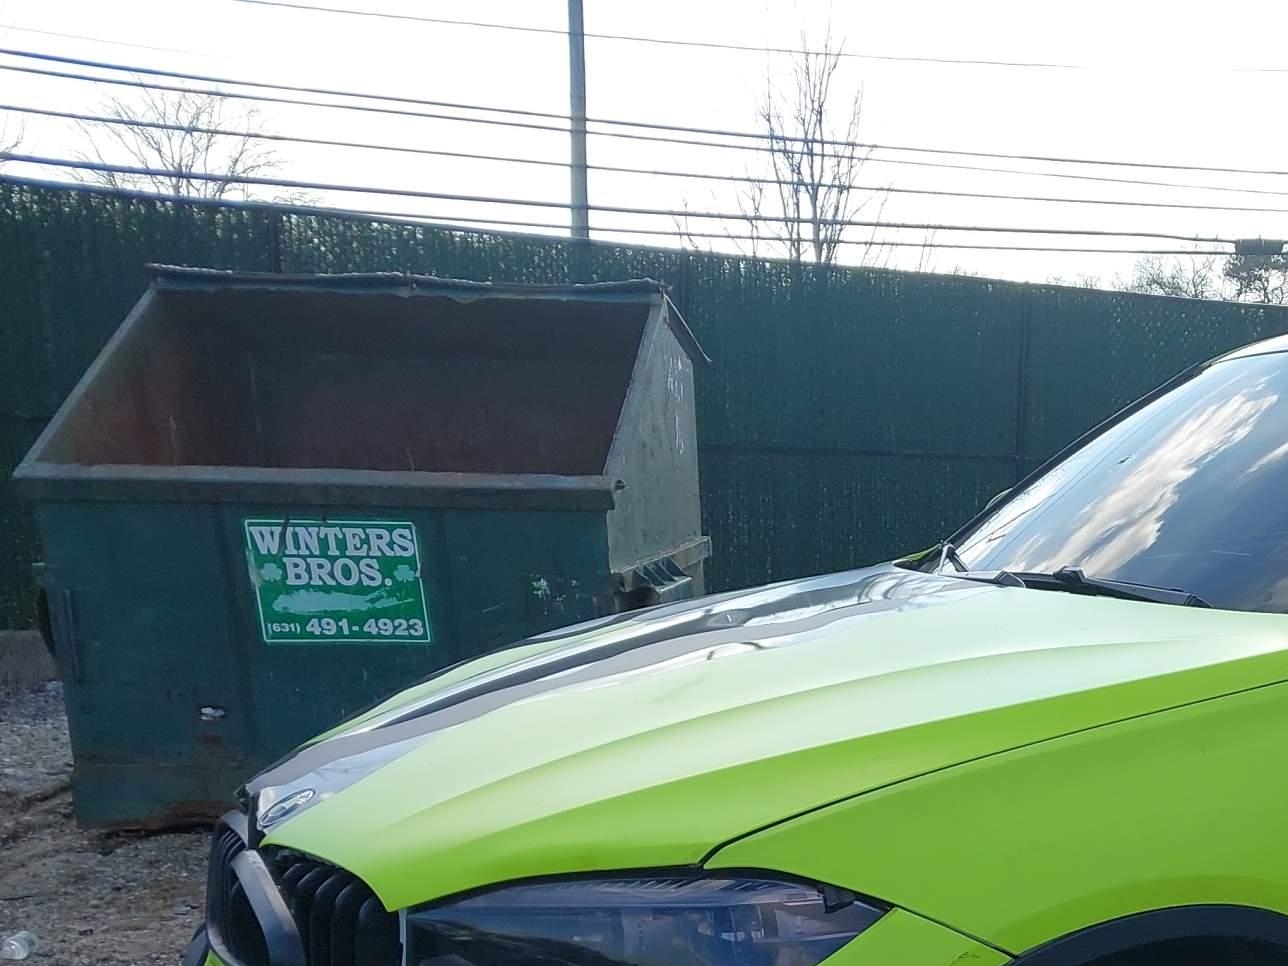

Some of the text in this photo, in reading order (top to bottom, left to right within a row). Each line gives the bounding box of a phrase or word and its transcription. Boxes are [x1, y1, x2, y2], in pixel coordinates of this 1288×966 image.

[249, 526, 415, 557] WINTERS
[282, 557, 393, 587] BROS.
[267, 617, 424, 636] (631) 491-4923
